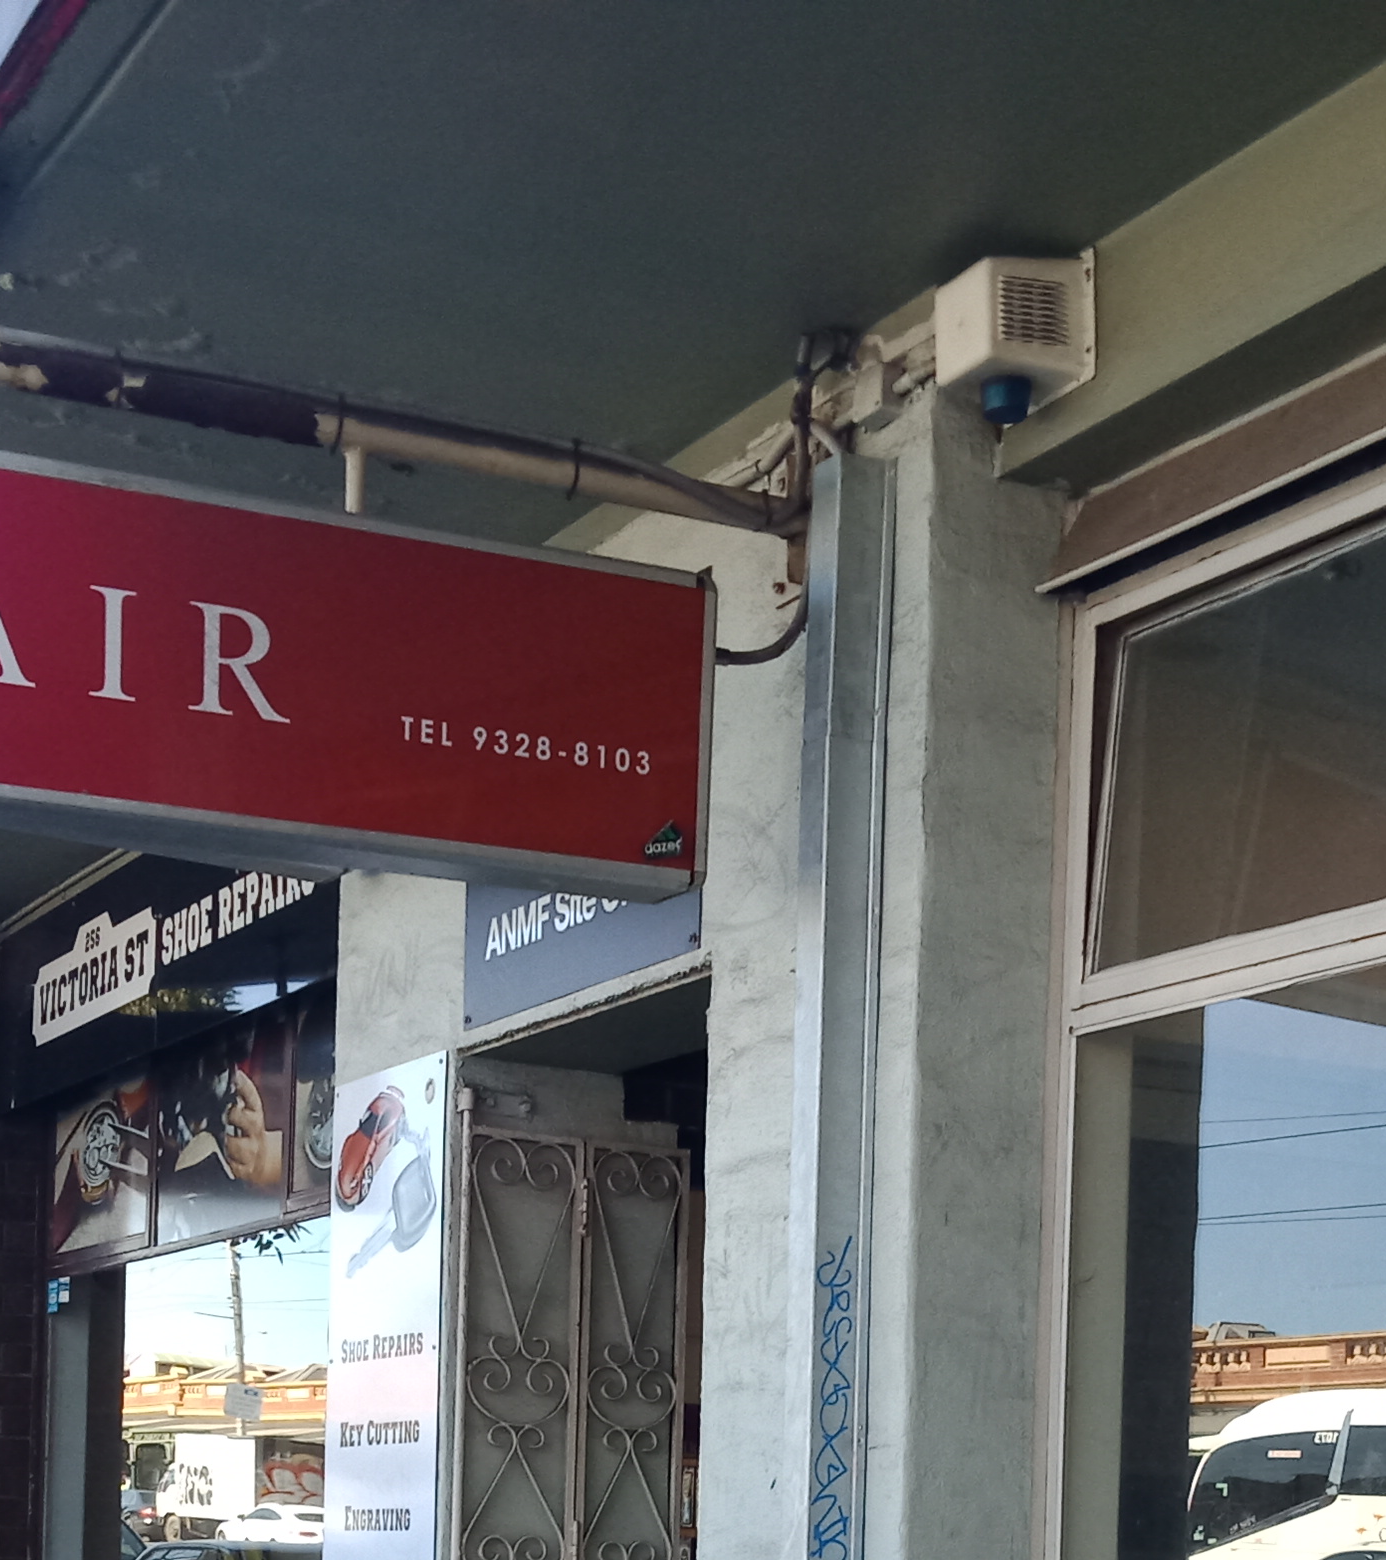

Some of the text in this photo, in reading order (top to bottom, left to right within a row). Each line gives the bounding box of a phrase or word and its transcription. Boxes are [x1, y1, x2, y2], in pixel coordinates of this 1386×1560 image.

[401, 715, 651, 775] TEL 9328-8103
[84, 926, 101, 953] 256
[485, 892, 552, 961] ANMF
[39, 870, 315, 1026] VICTORIA ST SHOE REPAIR
[341, 1332, 424, 1364] SHOE REPAIRS
[340, 1419, 420, 1448] KEY CUTTING
[344, 1505, 411, 1532] ENGRAVING
